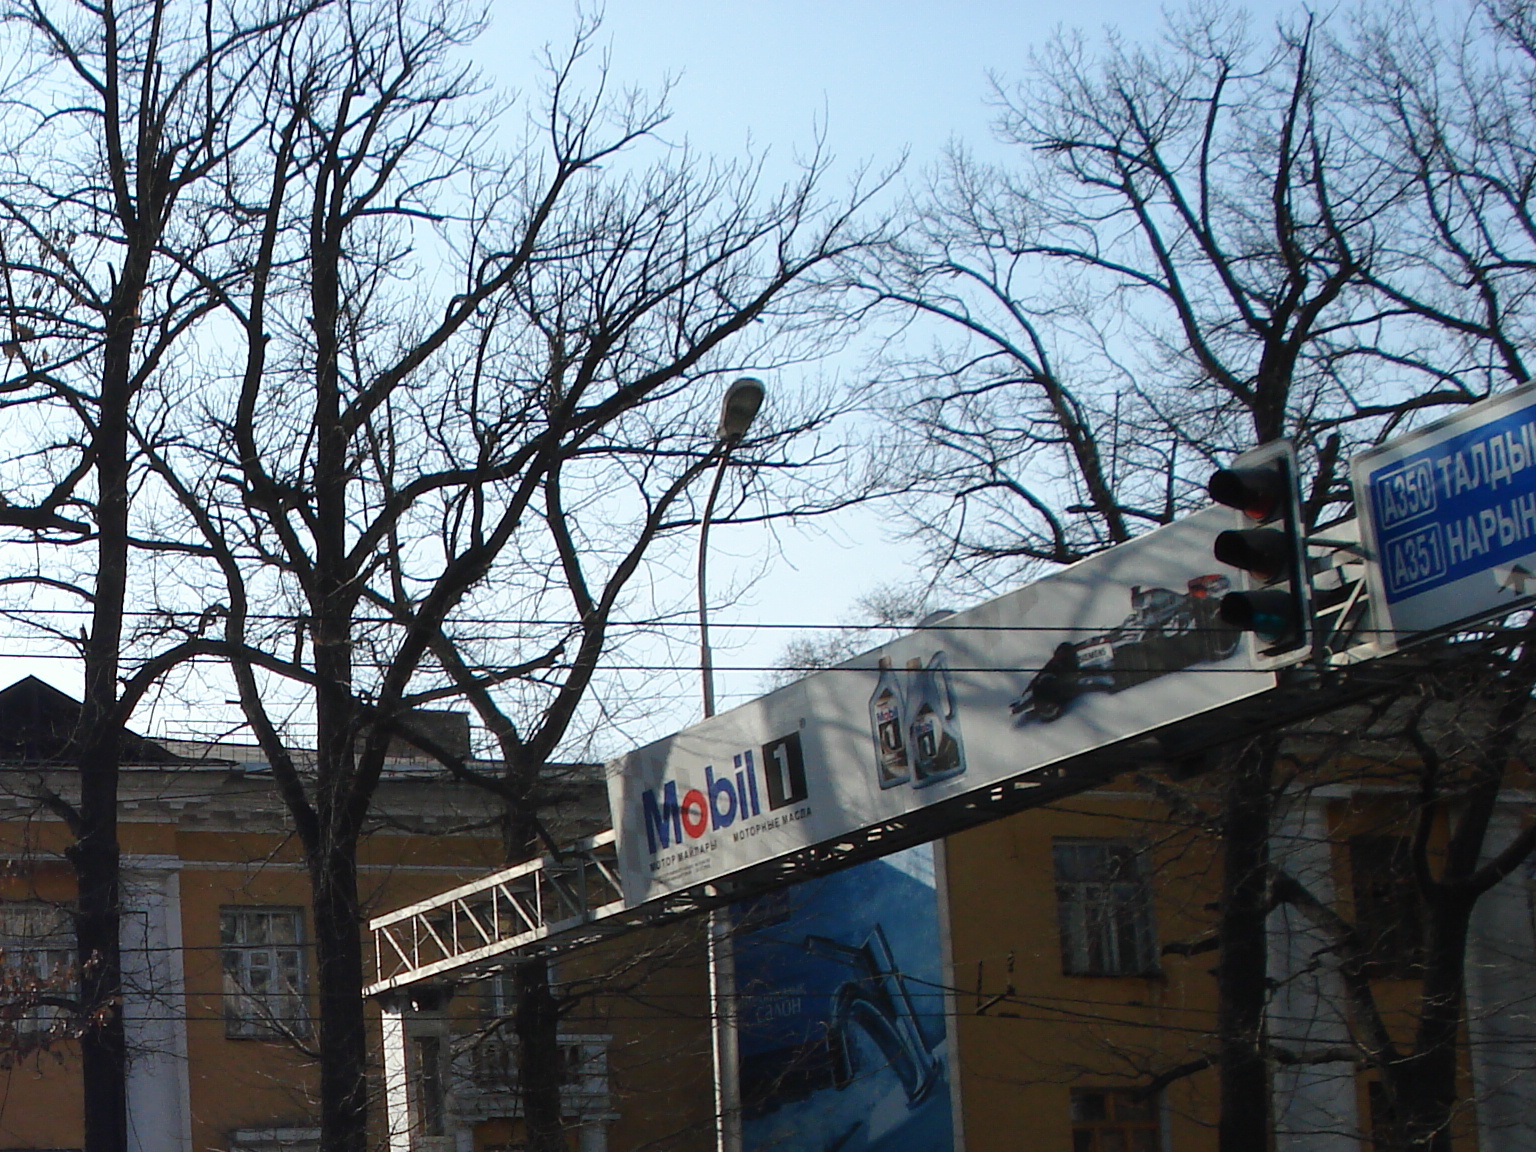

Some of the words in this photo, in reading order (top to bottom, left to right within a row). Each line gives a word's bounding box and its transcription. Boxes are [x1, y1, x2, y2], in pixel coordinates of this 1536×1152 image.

[1446, 492, 1536, 565] НАРЫН
[642, 750, 760, 855] Mobil
[733, 817, 781, 843] МОТОРНЫЕ
